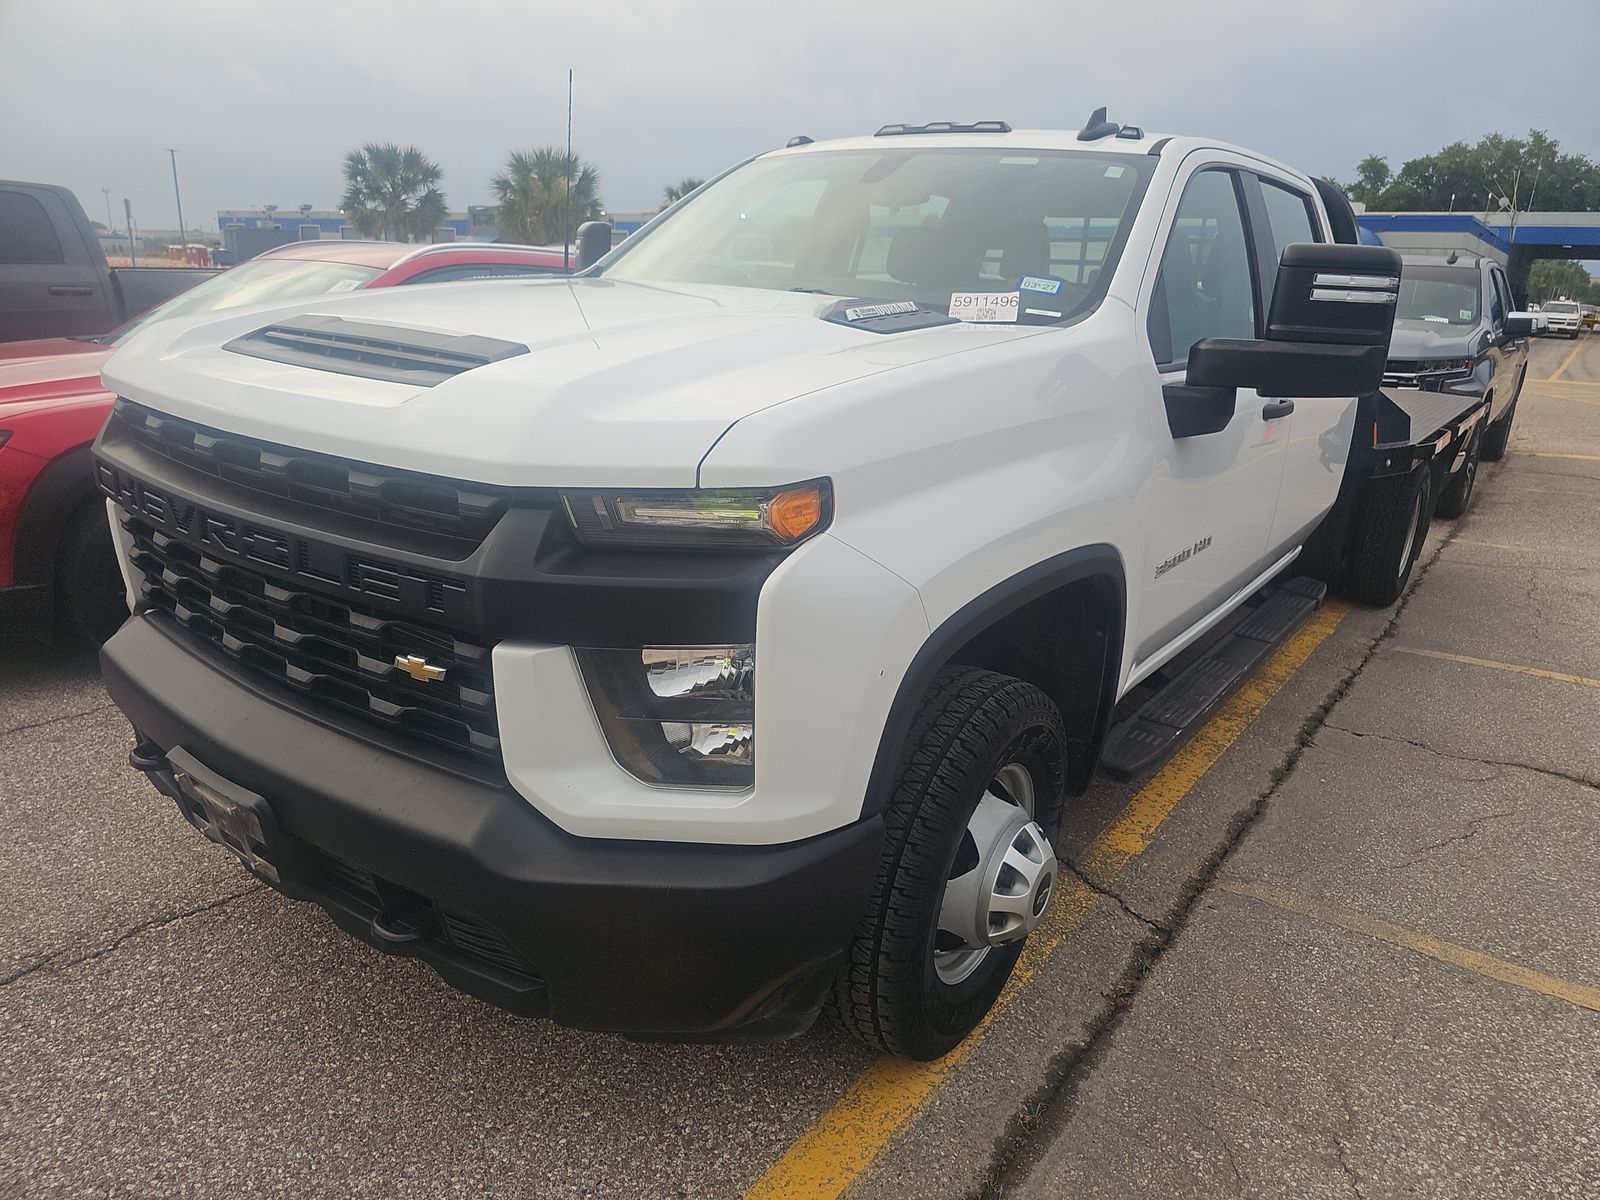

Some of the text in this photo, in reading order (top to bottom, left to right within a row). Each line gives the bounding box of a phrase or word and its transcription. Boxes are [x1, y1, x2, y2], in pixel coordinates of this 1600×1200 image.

[1023, 280, 1038, 288] 03
[1042, 284, 1057, 292] 27
[953, 295, 1019, 308] 5911496
[98, 463, 467, 613] CHEVROLET
